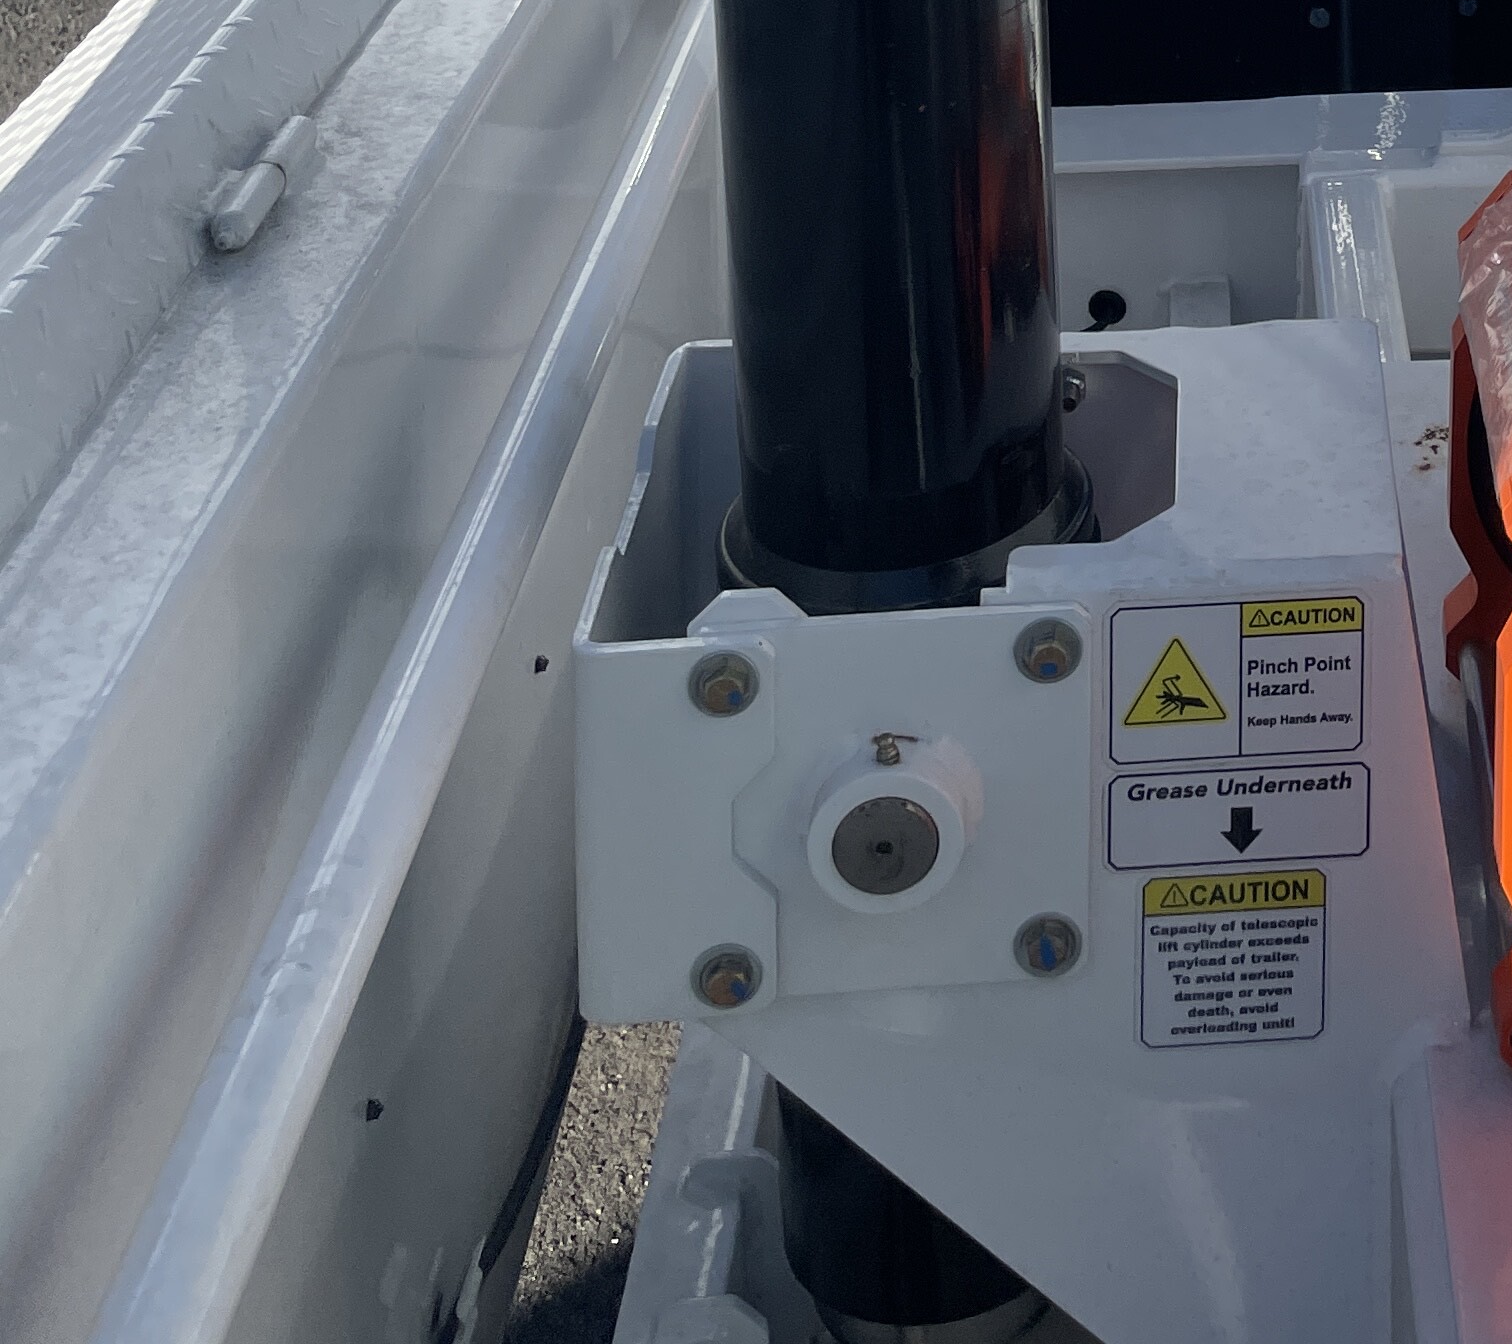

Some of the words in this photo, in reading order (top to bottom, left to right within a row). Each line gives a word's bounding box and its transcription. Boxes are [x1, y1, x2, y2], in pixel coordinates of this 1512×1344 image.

[1270, 606, 1356, 626] CAUTION
[1247, 657, 1298, 676] Pinch
[1304, 655, 1352, 672] Point
[1247, 679, 1315, 698] Hazard.
[1247, 716, 1277, 728] Keep
[1279, 713, 1317, 726] Hands
[1319, 712, 1354, 725] Away.
[1127, 782, 1208, 802] Grease
[1216, 770, 1352, 796] Underneath
[1190, 878, 1309, 907] CAUTION
[1150, 923, 1217, 937] Capacity
[1220, 920, 1236, 932] of
[1241, 916, 1319, 932] telescopic
[1158, 941, 1179, 953] lift
[1183, 938, 1244, 954] cylinder
[1247, 934, 1310, 948] exceeds
[1167, 955, 1226, 971] payload
[1231, 953, 1246, 965] of
[1250, 951, 1300, 964] trailer.
[1172, 973, 1191, 986] To
[1195, 971, 1235, 985] avoid
[1239, 968, 1294, 983] serious
[1174, 990, 1234, 1002] damage
[1238, 987, 1254, 998] or
[1257, 986, 1293, 997] even
[1187, 1005, 1235, 1018] death,
[1238, 1002, 1279, 1015] avoid
[1170, 1019, 1257, 1035] overloading
[1261, 1016, 1295, 1031] unit!
